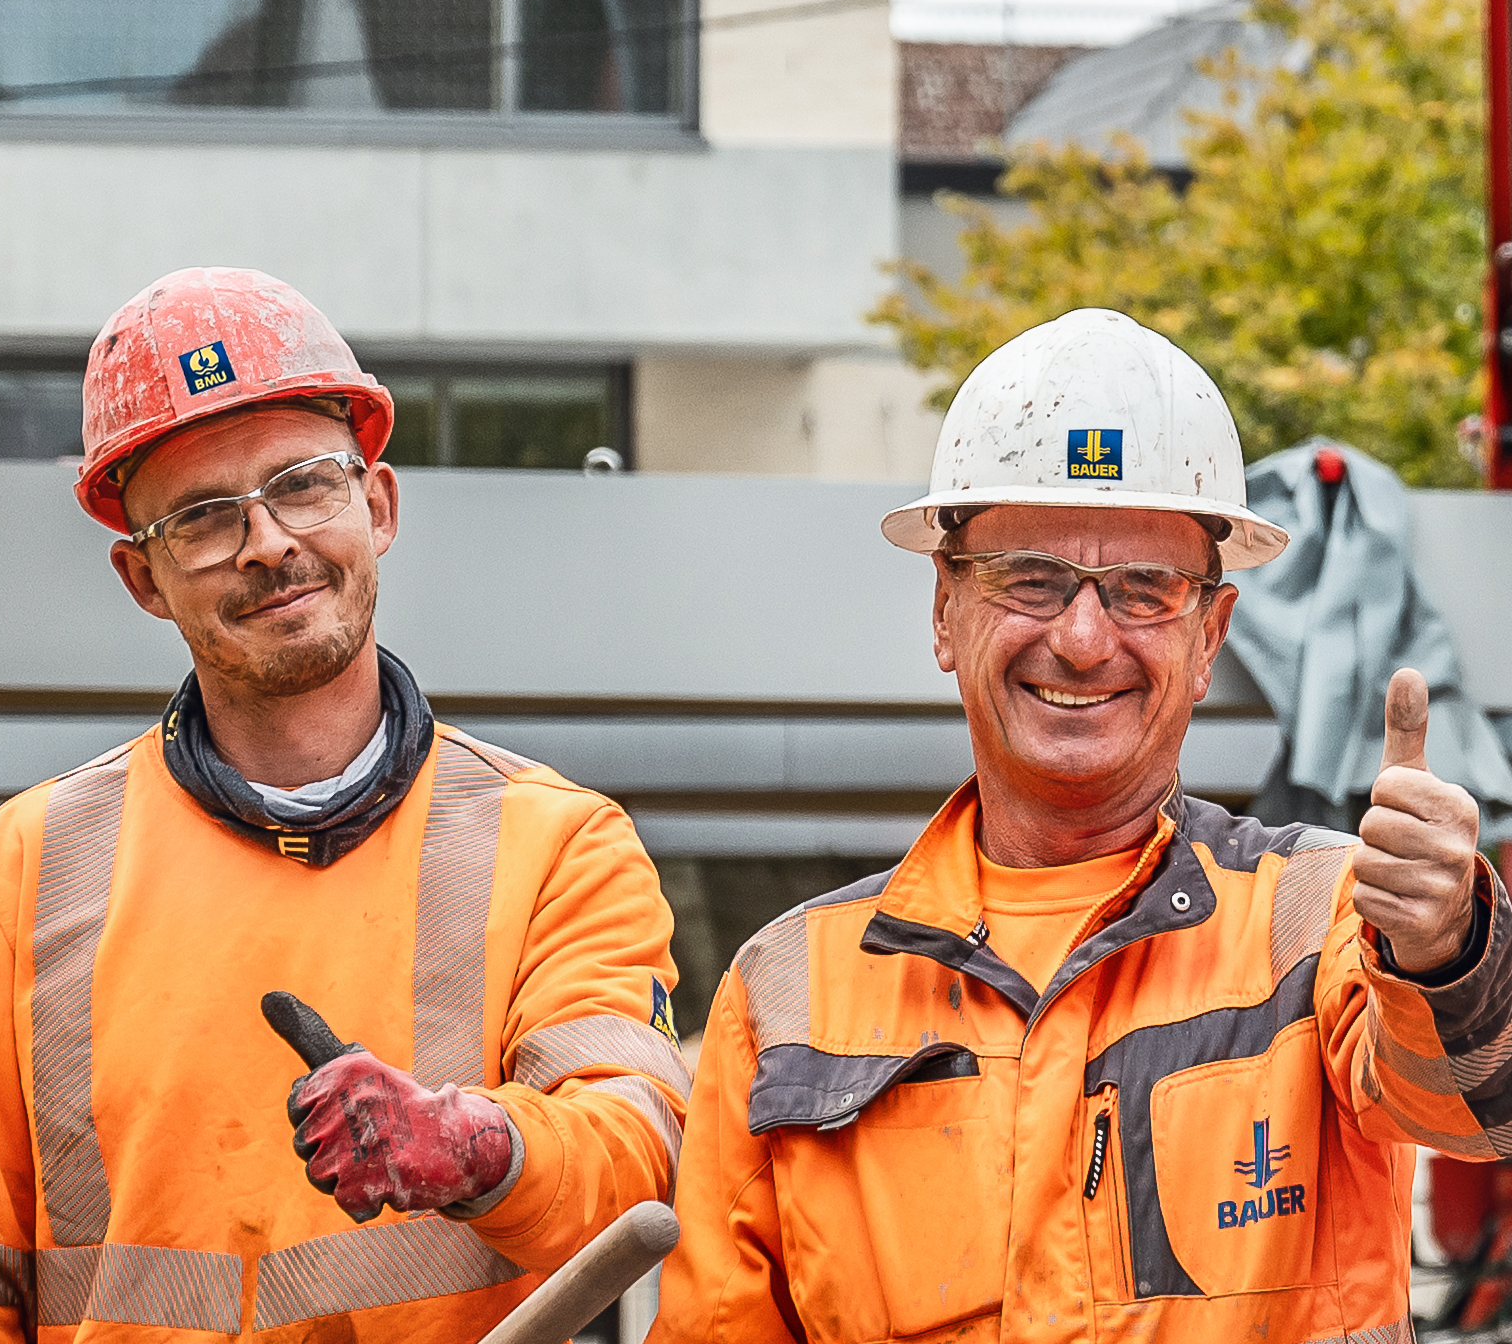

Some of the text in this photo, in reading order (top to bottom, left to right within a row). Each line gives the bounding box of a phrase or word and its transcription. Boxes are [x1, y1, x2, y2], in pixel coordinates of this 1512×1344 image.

[194, 369, 228, 391] BMU
[1070, 463, 1119, 478] BAUER
[1217, 1184, 1305, 1230] BAUER
